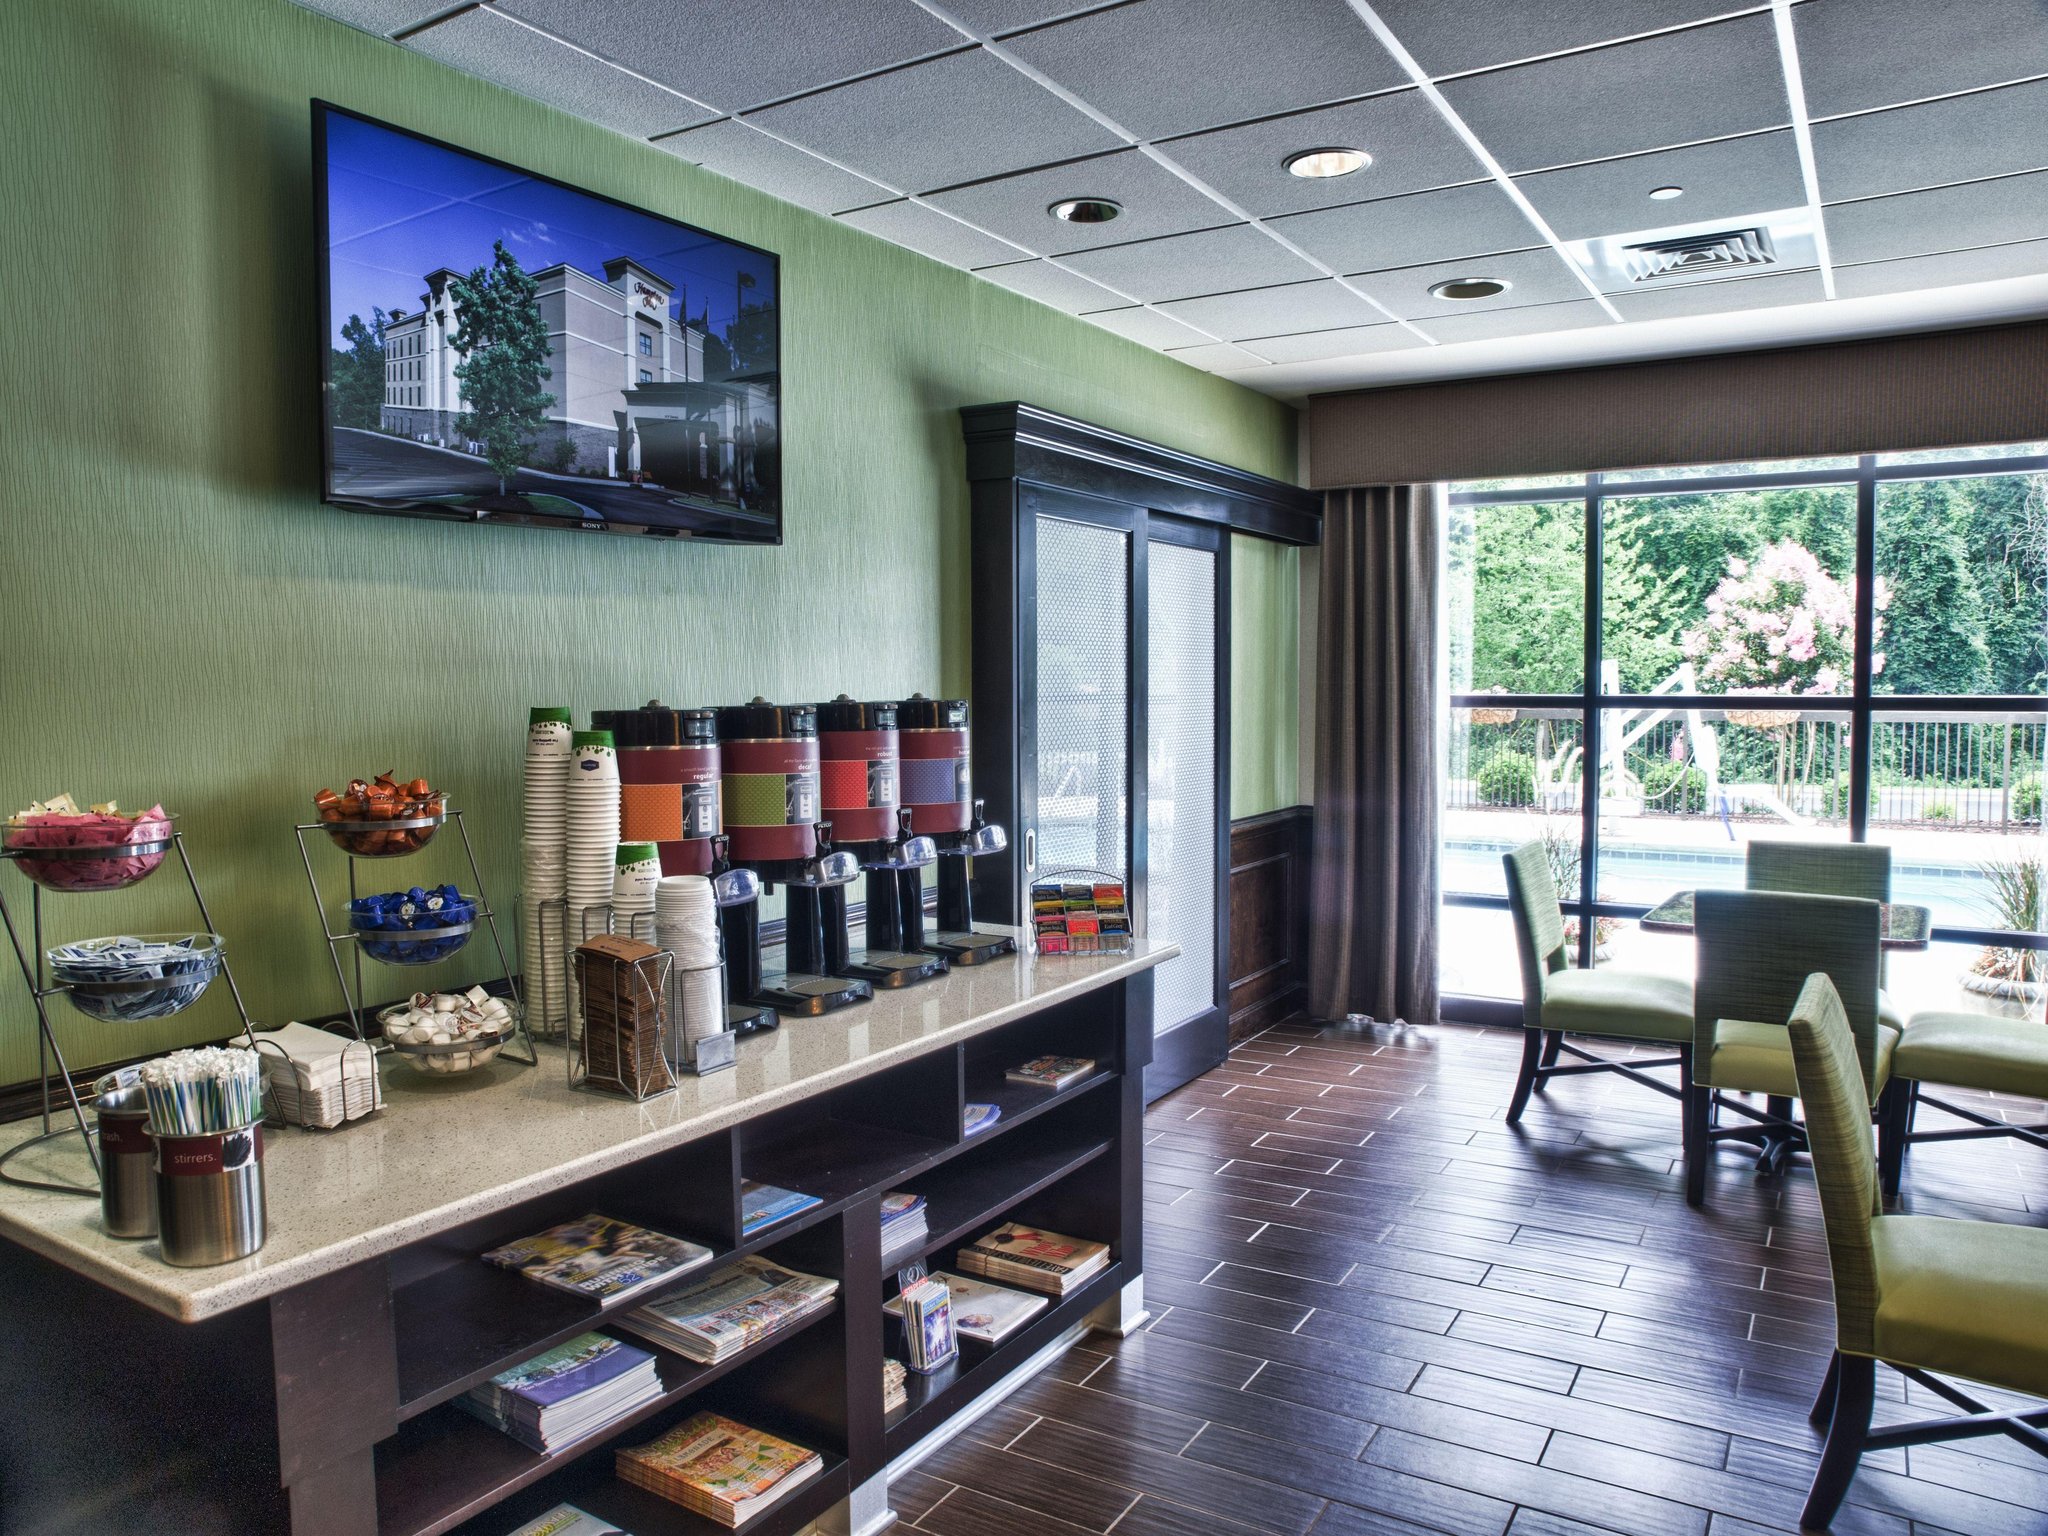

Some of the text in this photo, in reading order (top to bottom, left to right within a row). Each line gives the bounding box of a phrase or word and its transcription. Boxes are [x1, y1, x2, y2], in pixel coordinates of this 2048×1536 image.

[634, 281, 664, 305] Hampton
[693, 771, 714, 780] regular
[174, 1153, 217, 1164] stirrers.
[577, 1259, 646, 1287] RUNNING
[618, 1273, 641, 1285] 52
